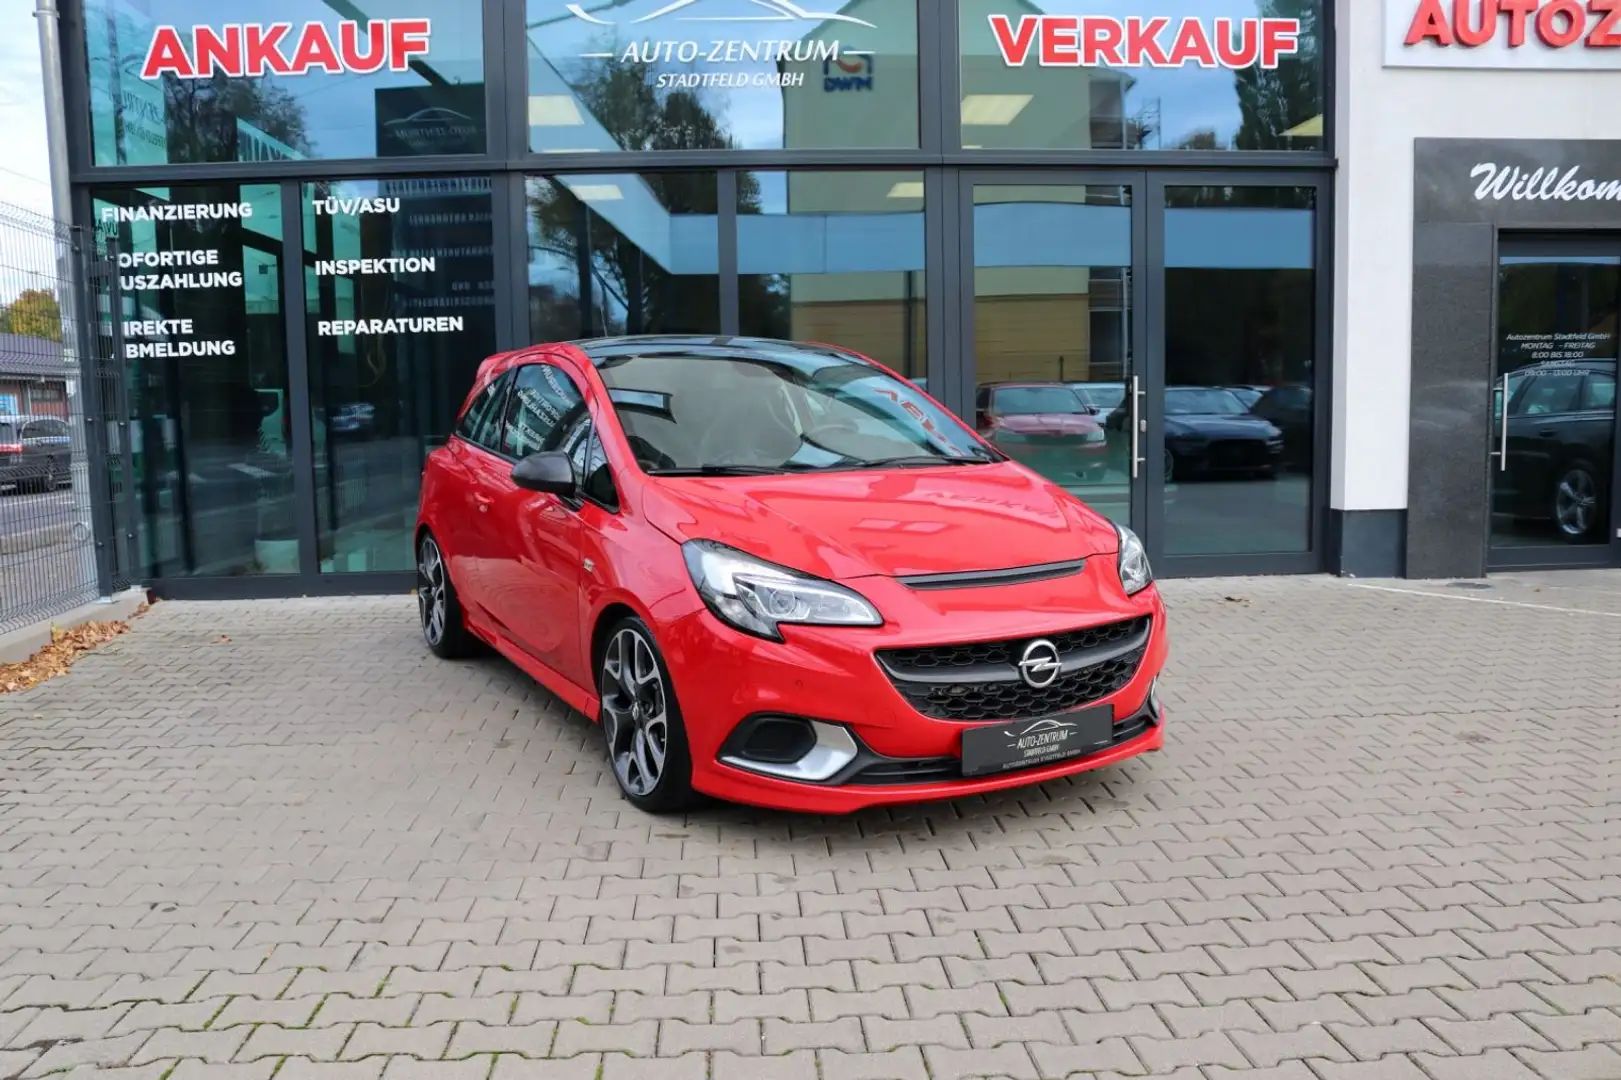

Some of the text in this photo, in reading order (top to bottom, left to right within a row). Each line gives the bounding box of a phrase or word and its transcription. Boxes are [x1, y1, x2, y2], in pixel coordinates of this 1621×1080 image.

[1403, 0, 1621, 48] AUTOZ
[140, 18, 432, 80] ANKAUF
[620, 39, 840, 64] AUTO-ZENTRUM
[987, 14, 1300, 70] VERKAUF
[656, 72, 805, 89] STADTFELD GMBH
[1469, 162, 1621, 201] Willkom
[101, 202, 253, 222] FINANZIERUNG
[312, 195, 400, 216] TÜV/ASU
[106, 249, 219, 268] OFORTIGE
[314, 257, 436, 276] INSPEKTION
[107, 271, 243, 291] USZAHLUNG
[110, 318, 194, 337] IREKTE
[317, 316, 464, 336] REPARATUREN
[112, 340, 236, 359] BMELDUNG
[1016, 729, 1069, 750] AUTO-ZENTRUM
